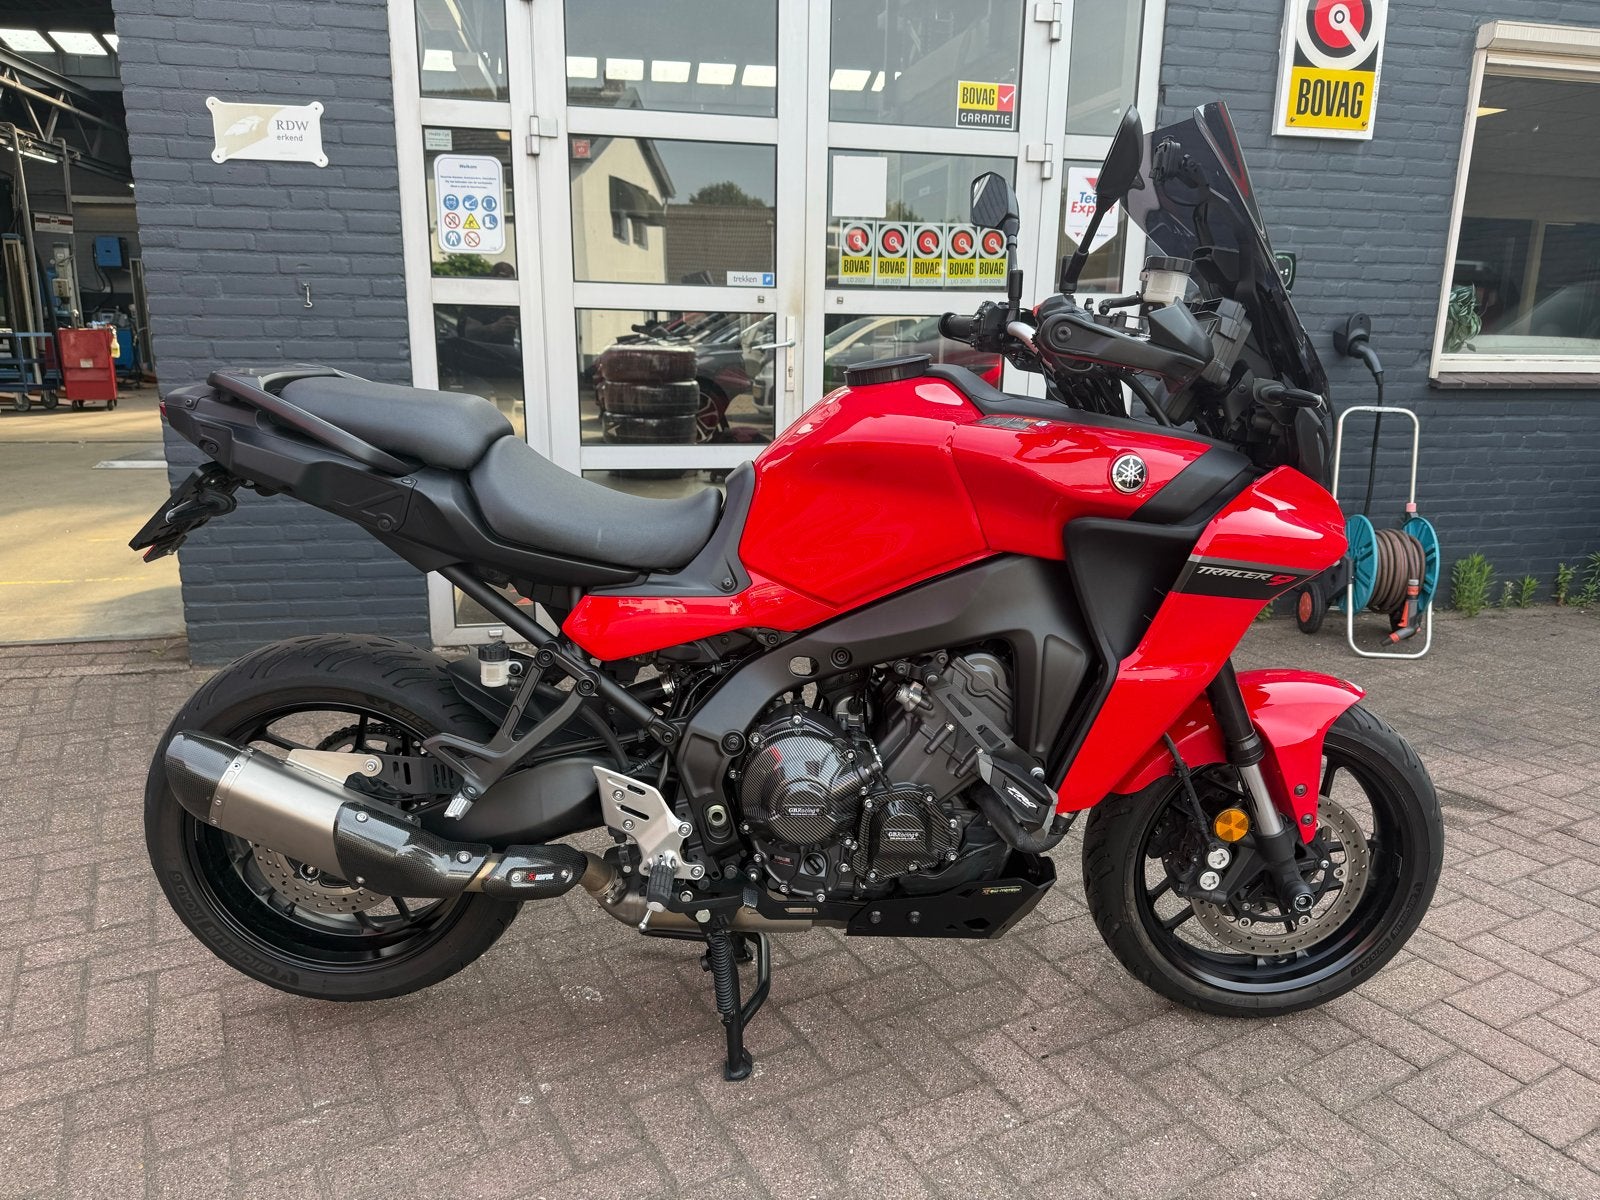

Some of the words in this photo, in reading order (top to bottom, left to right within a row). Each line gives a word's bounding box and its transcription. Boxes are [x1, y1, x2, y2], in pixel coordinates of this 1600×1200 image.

[962, 87, 995, 106] BOVAG
[1296, 78, 1365, 119] BOVAG
[276, 120, 309, 131] RDW
[960, 112, 1010, 125] GARANTIE
[277, 134, 304, 142] erkend
[1080, 192, 1097, 204] Tec
[843, 259, 870, 274] BOVAG
[879, 260, 905, 275] BOVAG
[914, 261, 940, 275] BOVAG
[949, 262, 974, 275] BOVAG
[979, 261, 1004, 275] BOVAG
[733, 275, 758, 283] trekken
[174, 873, 182, 881] 6
[177, 885, 206, 922] ROAD
[205, 924, 275, 975] MICHELIN
